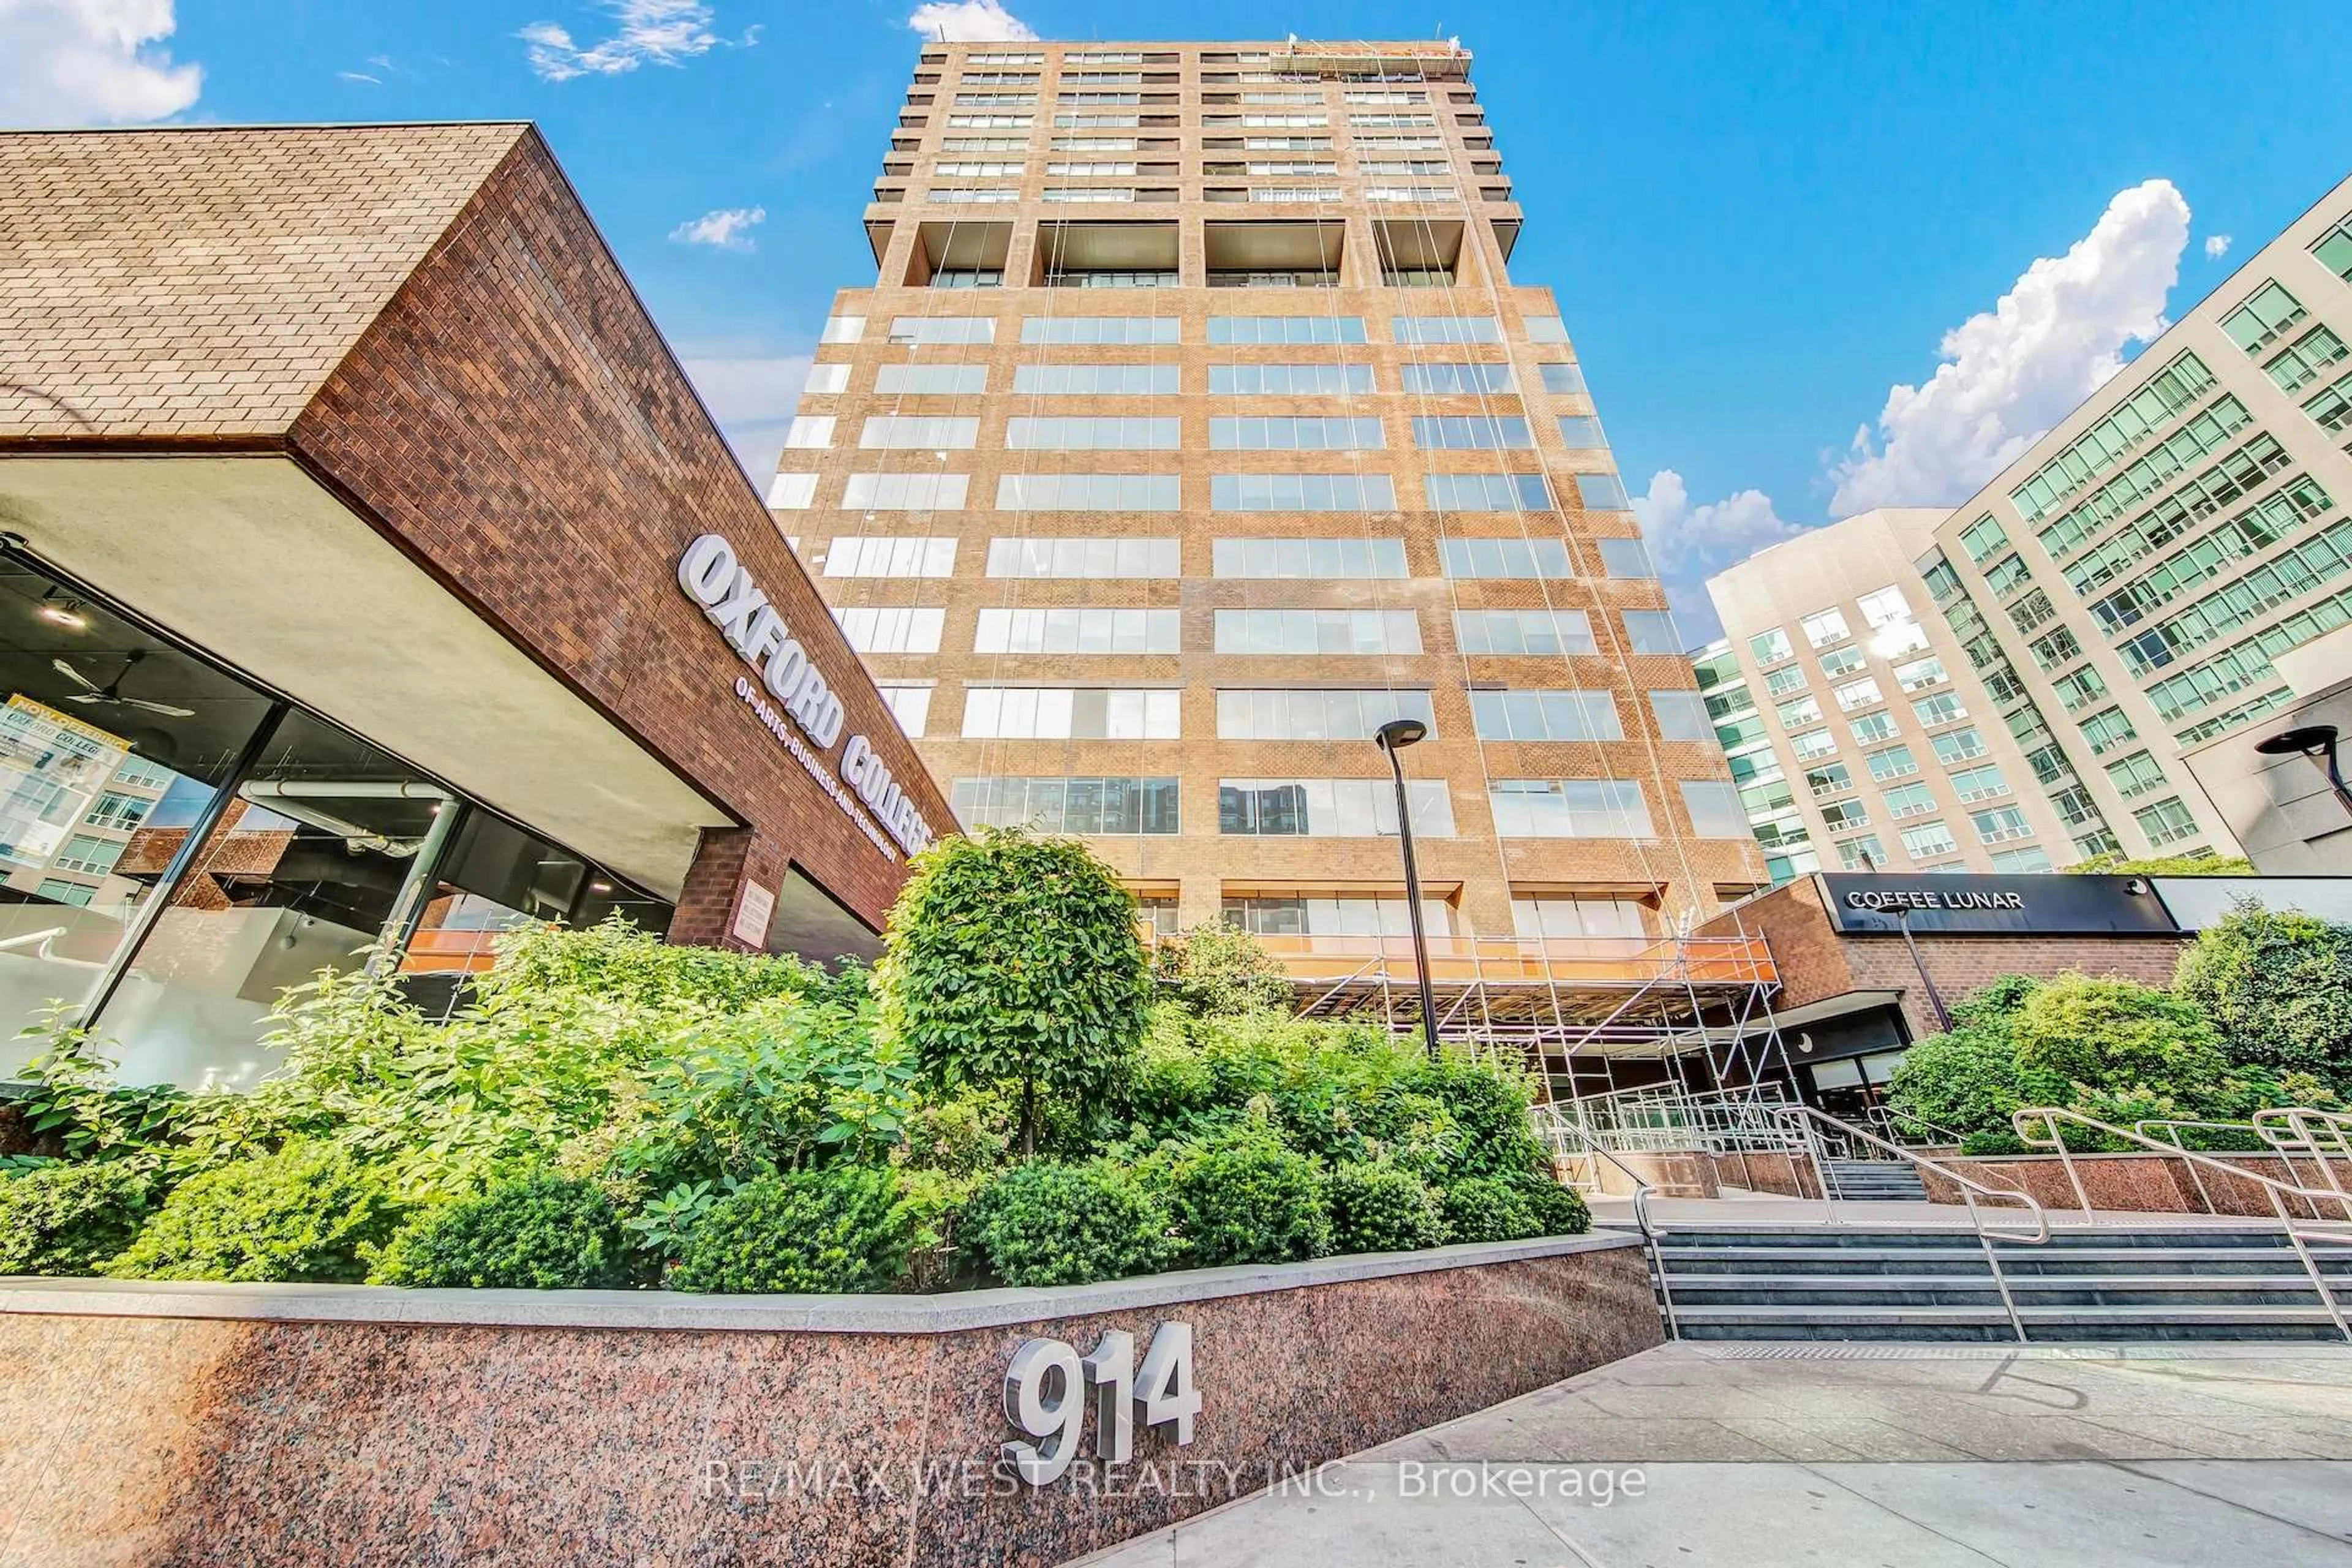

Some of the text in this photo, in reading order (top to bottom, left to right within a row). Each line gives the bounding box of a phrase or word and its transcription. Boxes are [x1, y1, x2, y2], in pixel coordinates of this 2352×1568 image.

[7, 712, 56, 736] OXFORD
[677, 533, 935, 856] OXFORD COLLEGE
[736, 676, 757, 704] OF
[789, 736, 837, 797] BUSINESS
[835, 790, 854, 816] AND
[853, 807, 897, 864] TECHNOLOGY
[1845, 891, 2025, 909] COFFEE LUNAR
[1000, 1321, 1202, 1486] 914
